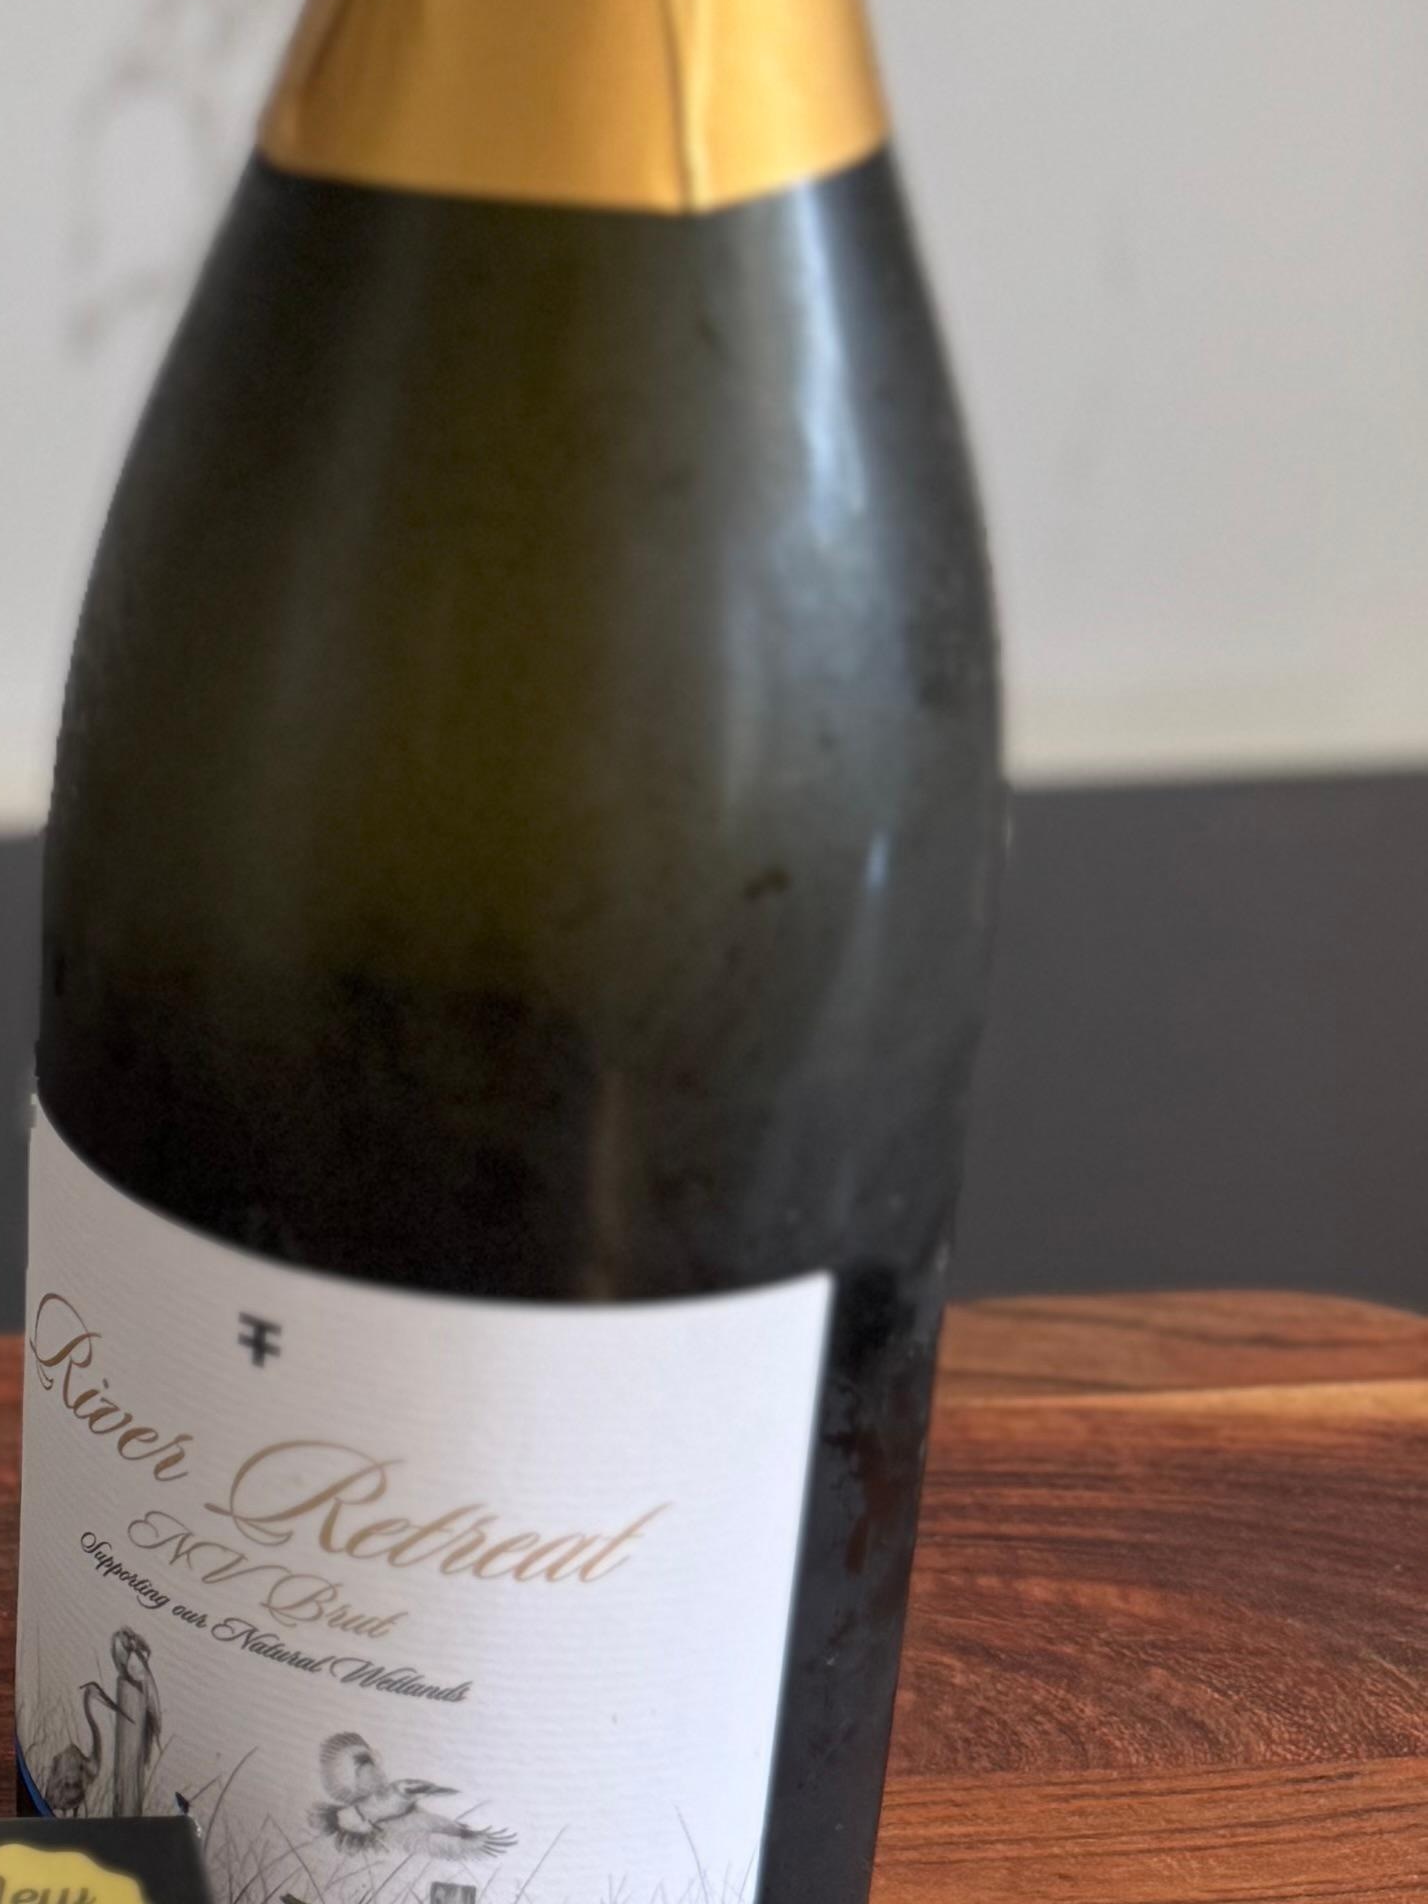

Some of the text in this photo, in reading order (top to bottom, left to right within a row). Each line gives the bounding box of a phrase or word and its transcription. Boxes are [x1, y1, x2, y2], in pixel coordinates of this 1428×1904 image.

[29, 1293, 675, 1584] River Retreat
[80, 1531, 472, 1703] Supporting our Natural Wetlands
[127, 1511, 408, 1639] NV Brut
